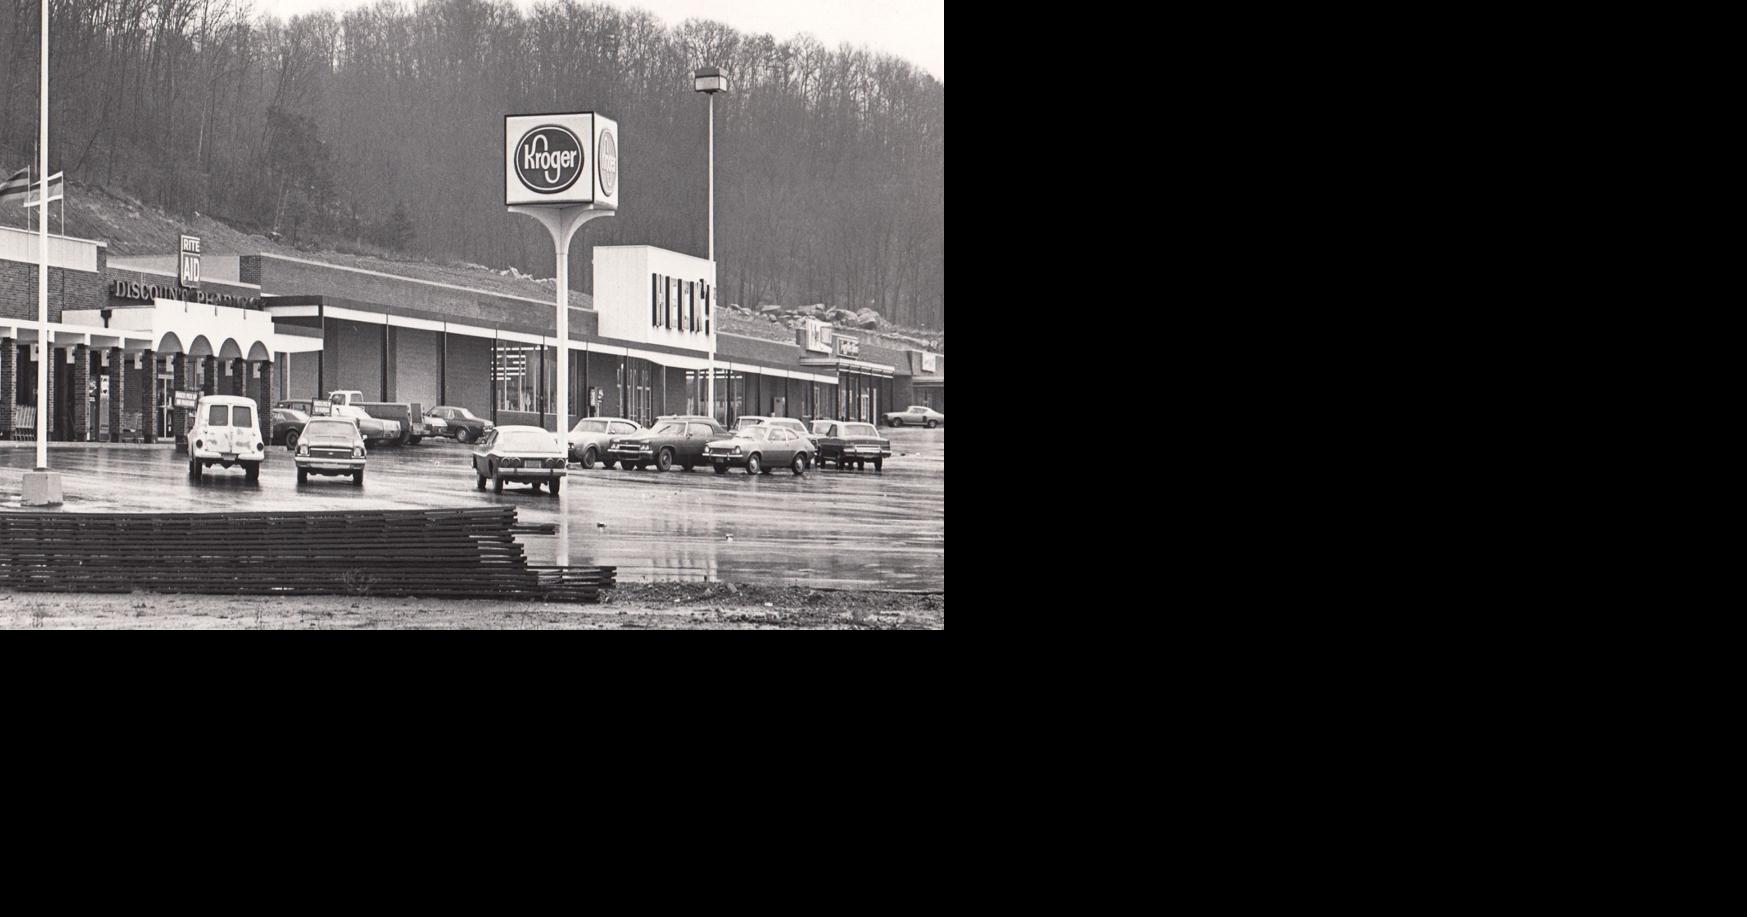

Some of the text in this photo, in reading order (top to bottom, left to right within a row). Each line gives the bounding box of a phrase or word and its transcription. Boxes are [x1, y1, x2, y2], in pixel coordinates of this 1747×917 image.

[524, 134, 577, 184] Kroger
[183, 238, 200, 252] RITE
[183, 256, 200, 282] AID
